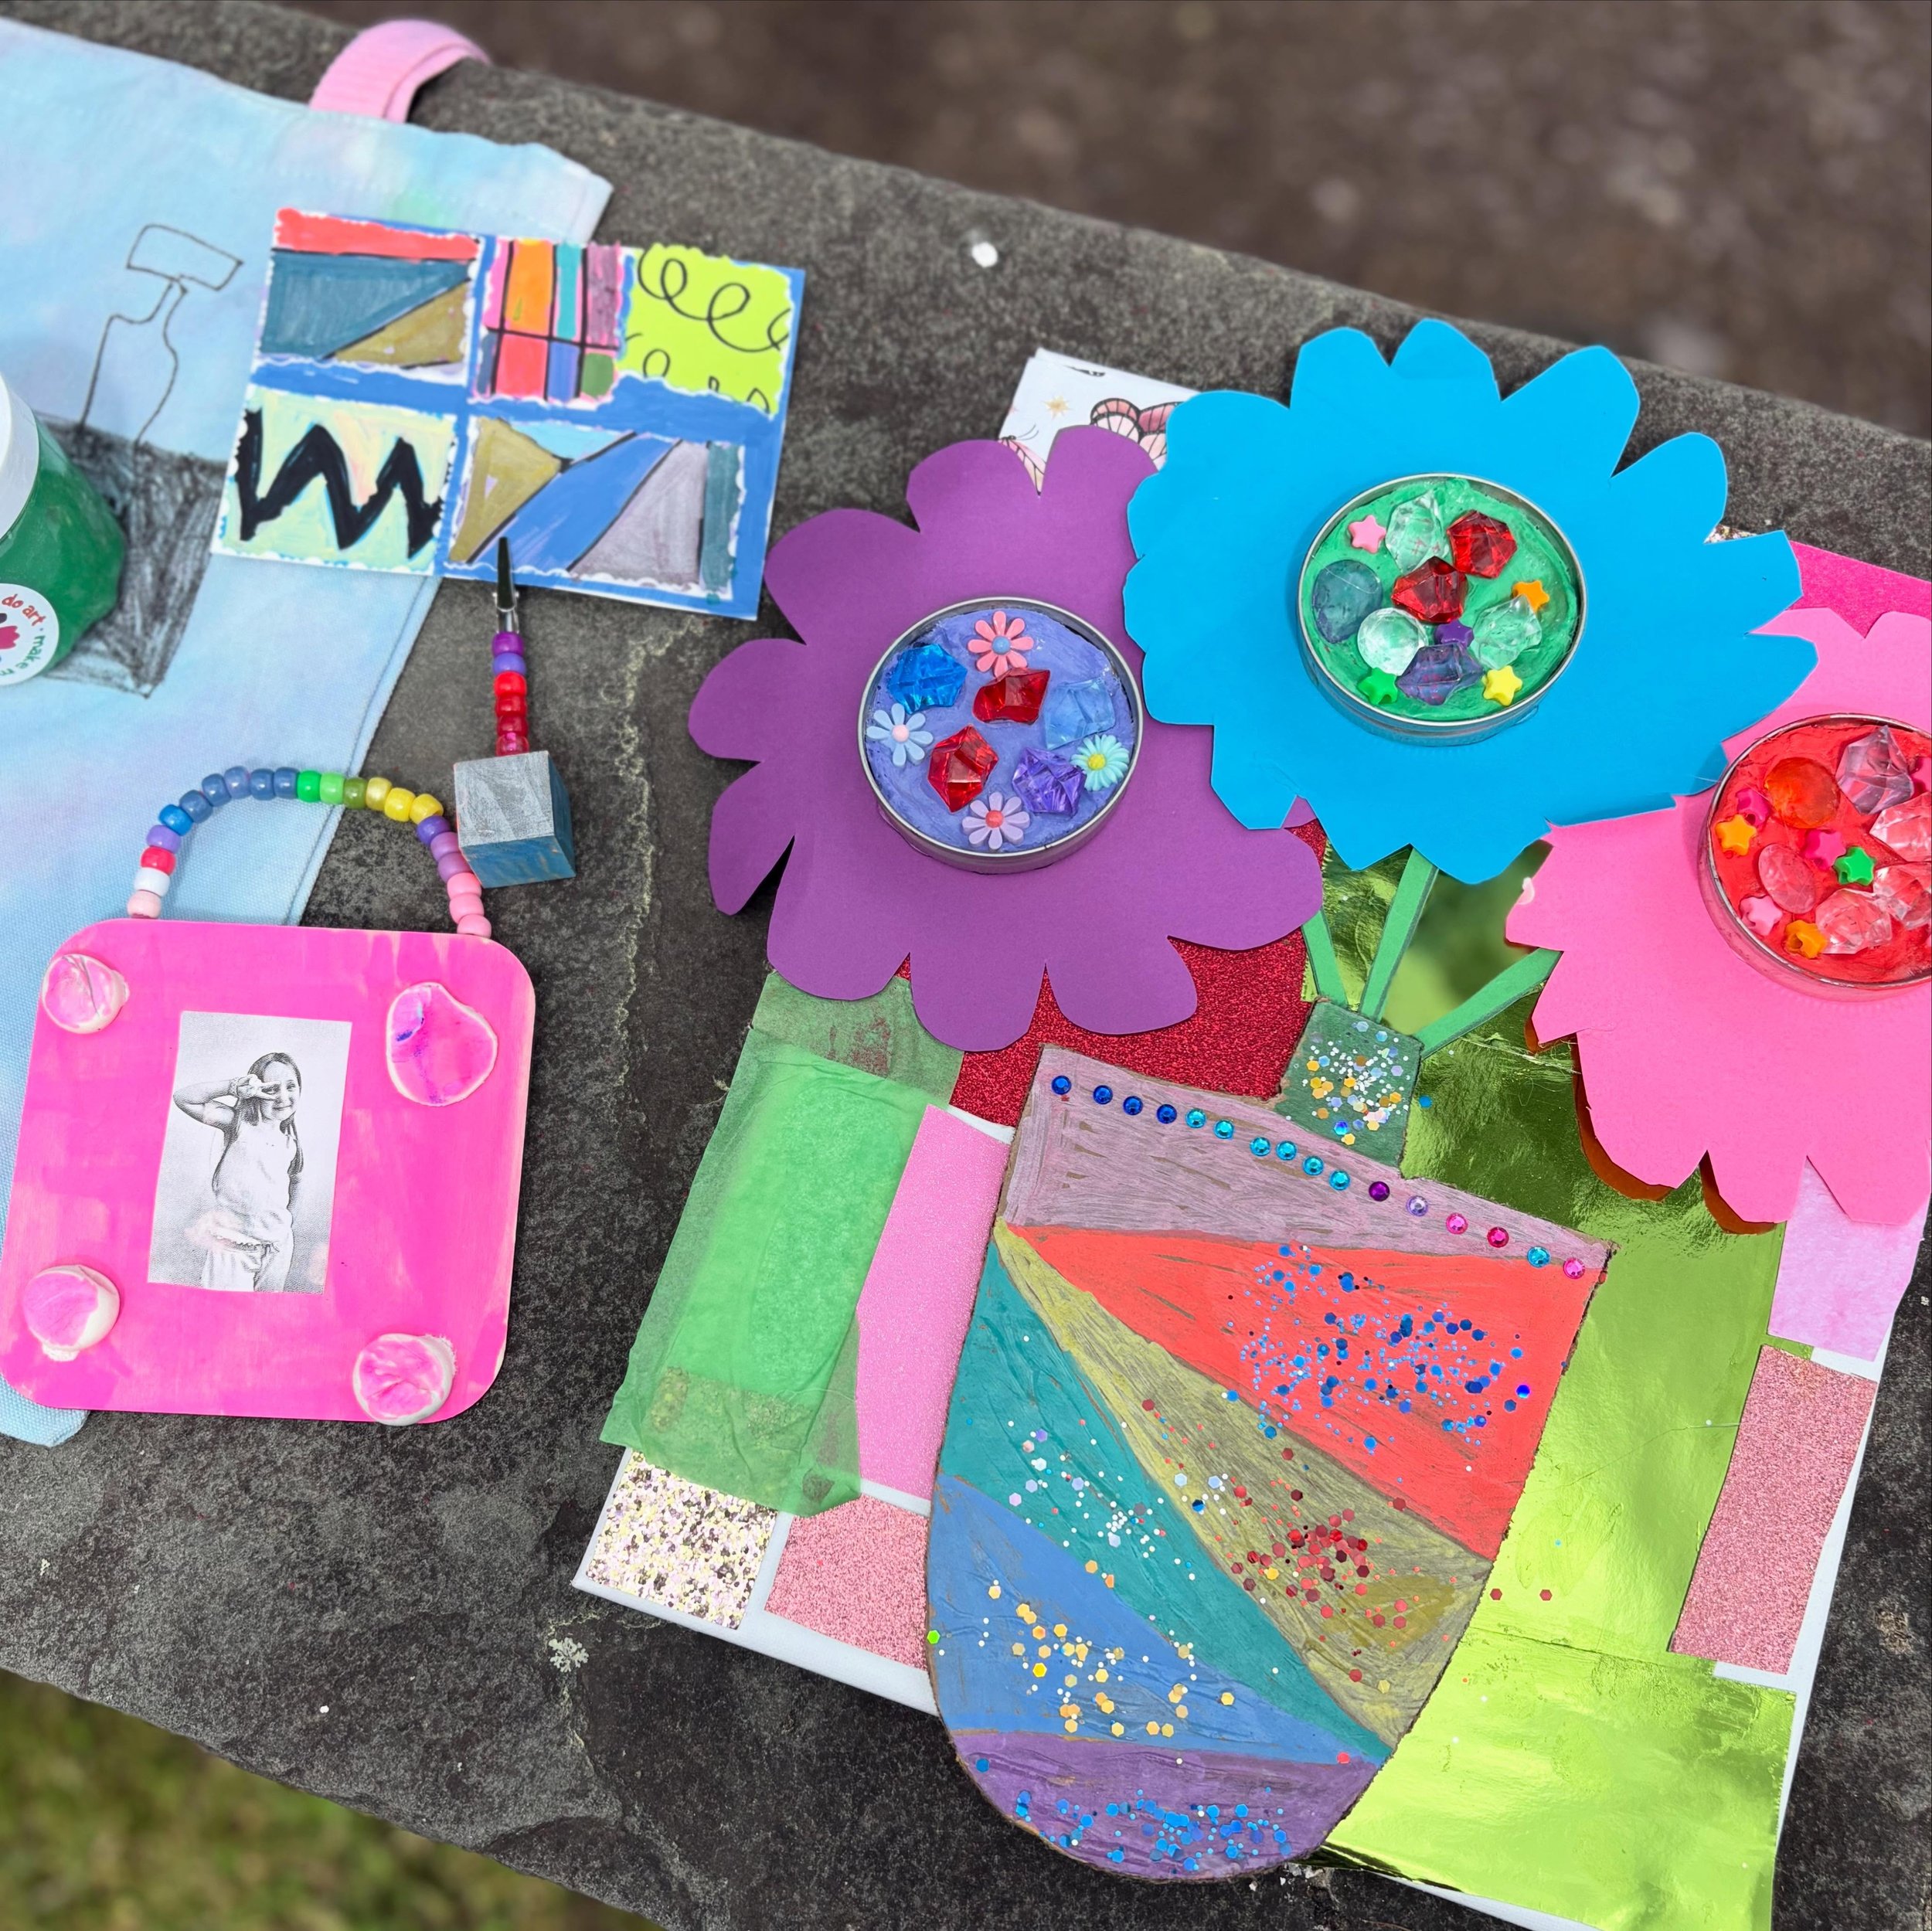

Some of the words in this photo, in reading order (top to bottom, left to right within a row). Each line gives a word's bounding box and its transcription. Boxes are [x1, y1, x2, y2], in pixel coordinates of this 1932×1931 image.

[2, 593, 24, 608] do
[22, 605, 46, 627] art
[15, 635, 46, 669] make
